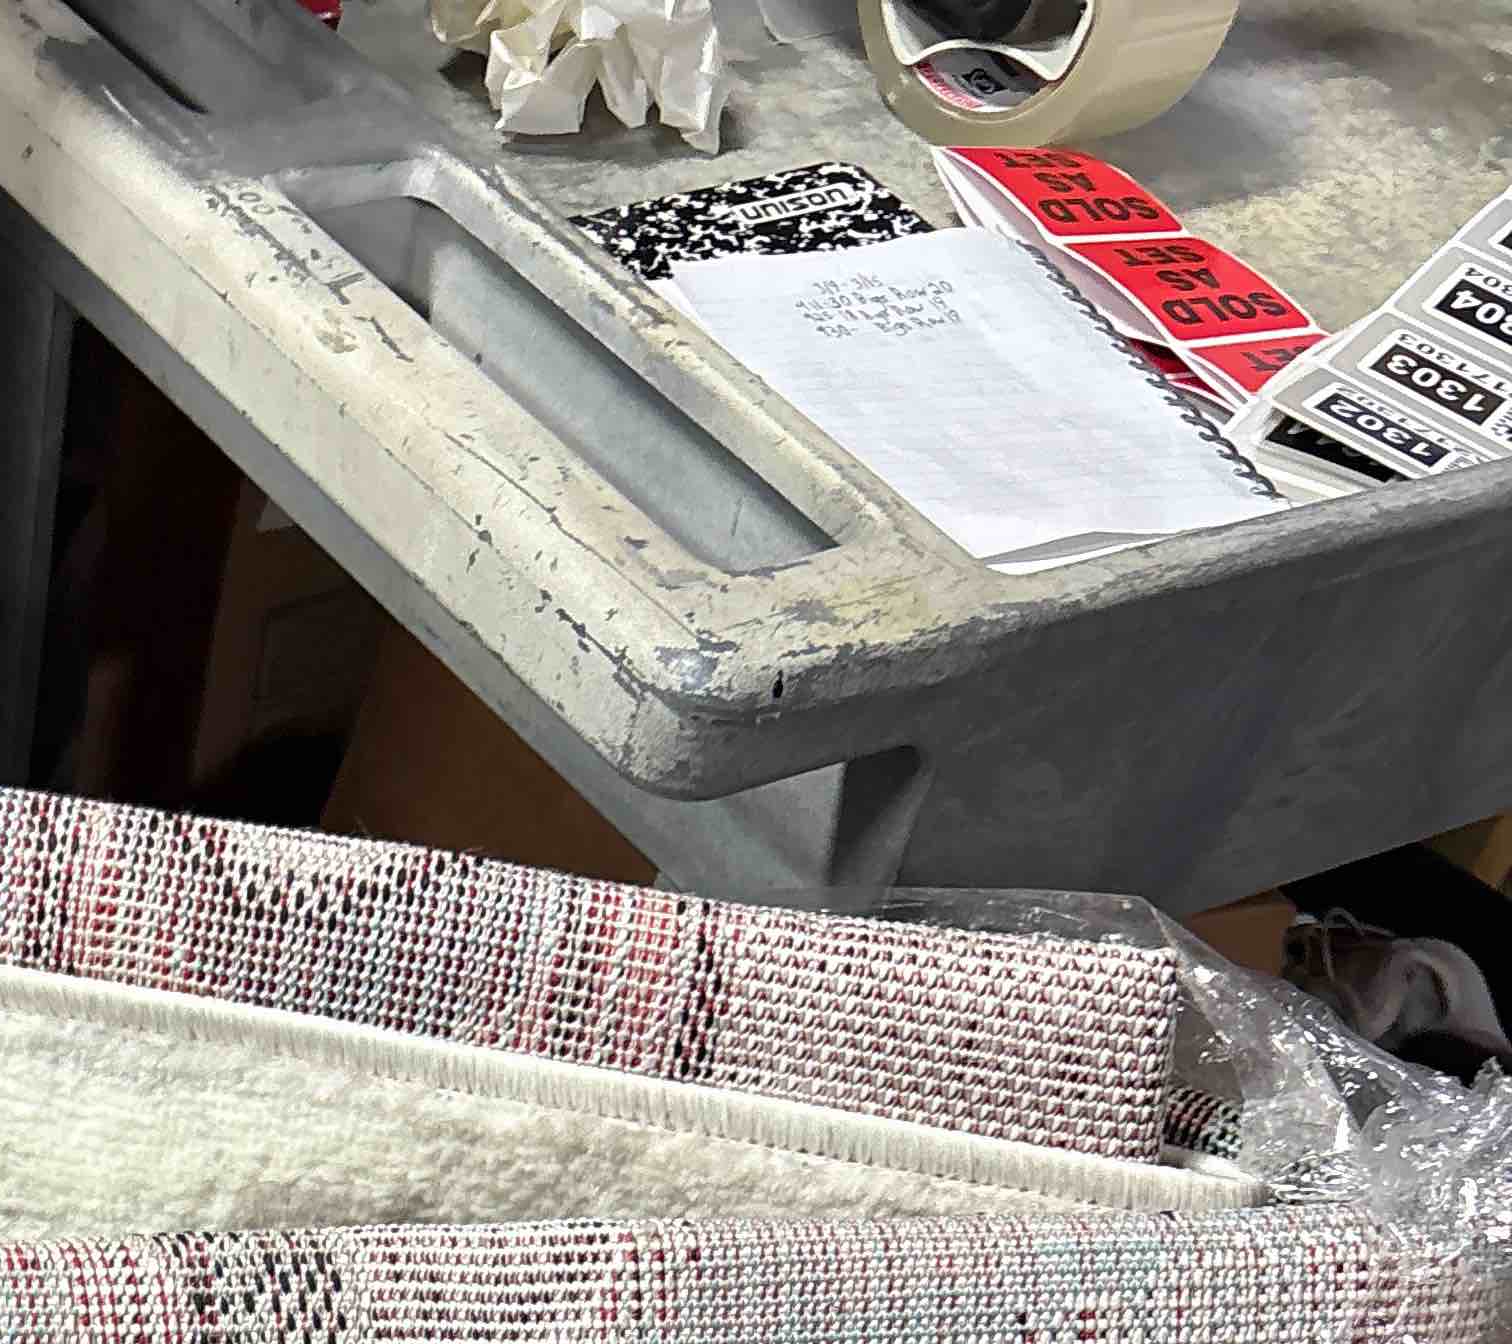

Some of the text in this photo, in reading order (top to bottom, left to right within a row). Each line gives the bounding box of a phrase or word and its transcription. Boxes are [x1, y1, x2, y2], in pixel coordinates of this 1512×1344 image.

[993, 150, 1082, 169] SET
[1034, 172, 1097, 193] AS
[1038, 196, 1160, 224] SOLD
[1113, 245, 1210, 267] SET
[1155, 268, 1221, 291] AS
[1162, 291, 1288, 325] SOLD
[1386, 353, 1486, 413] 1303
[1329, 399, 1433, 458] 1302
